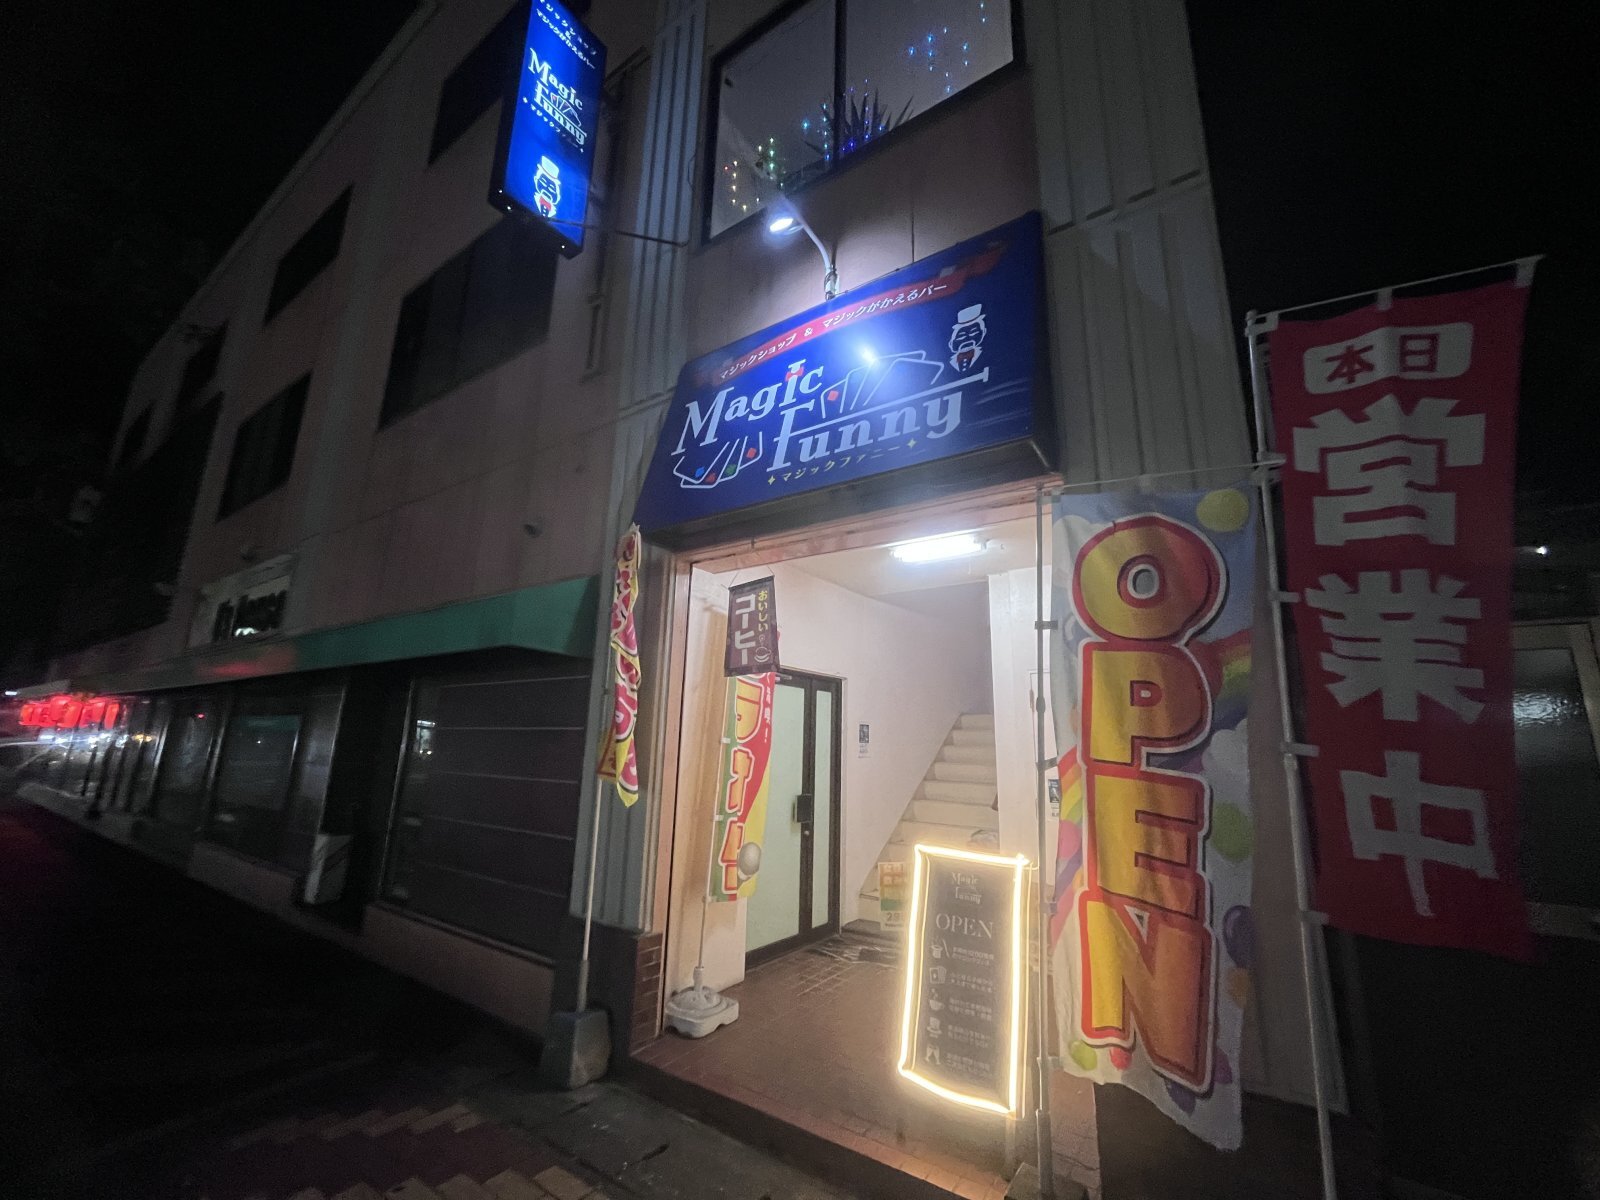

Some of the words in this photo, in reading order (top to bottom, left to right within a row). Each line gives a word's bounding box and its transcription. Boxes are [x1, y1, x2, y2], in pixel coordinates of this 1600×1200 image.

[528, 47, 584, 111] Magic
[533, 80, 588, 145] Funny
[719, 332, 797, 379] マジックショップ
[803, 326, 814, 338] &
[822, 283, 948, 329] マジックがかえるバー
[1327, 331, 1439, 384] 本日
[670, 359, 824, 456] Magic
[766, 367, 989, 473] Funny
[781, 445, 900, 482] マジックファニー
[734, 593, 756, 666] コーヒー
[757, 589, 769, 632] おいしい
[1292, 394, 1499, 918] 営業中
[1071, 512, 1228, 1100] OPEN
[936, 913, 994, 940] OPEN
